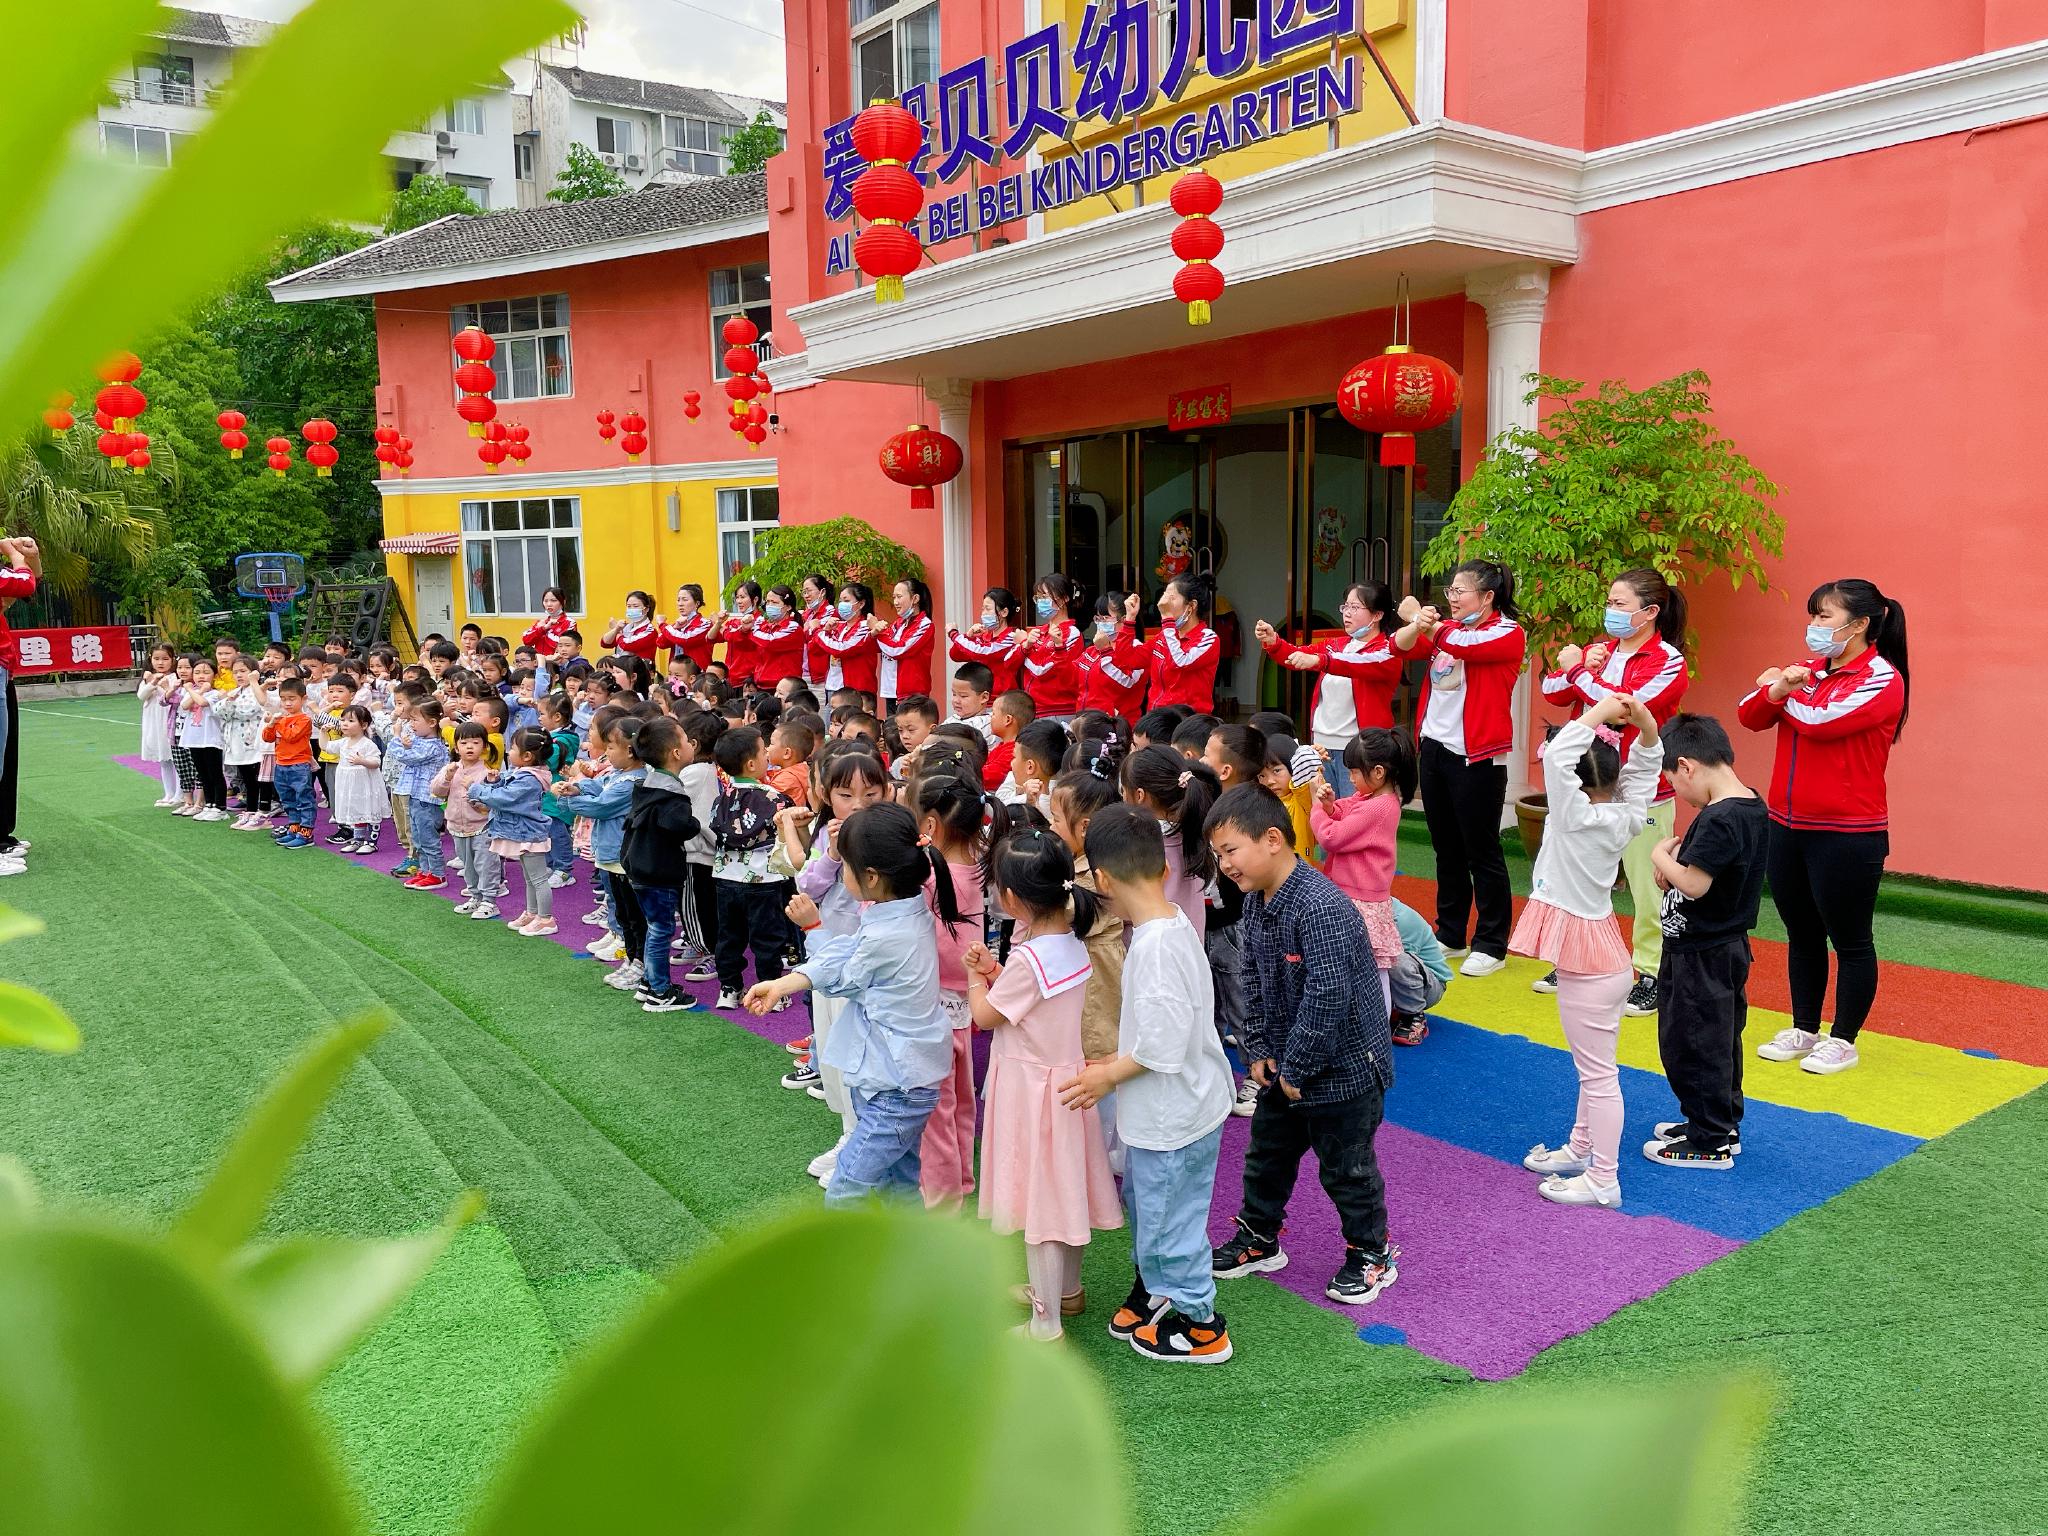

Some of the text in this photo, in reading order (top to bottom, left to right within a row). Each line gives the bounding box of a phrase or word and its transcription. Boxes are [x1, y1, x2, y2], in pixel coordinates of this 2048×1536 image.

[826, 233, 850, 276] AI
[928, 191, 969, 245] BEI
[978, 172, 1023, 229] BEI
[1031, 55, 1355, 211] KINDERGARTEN
[19, 633, 103, 667] 里路
